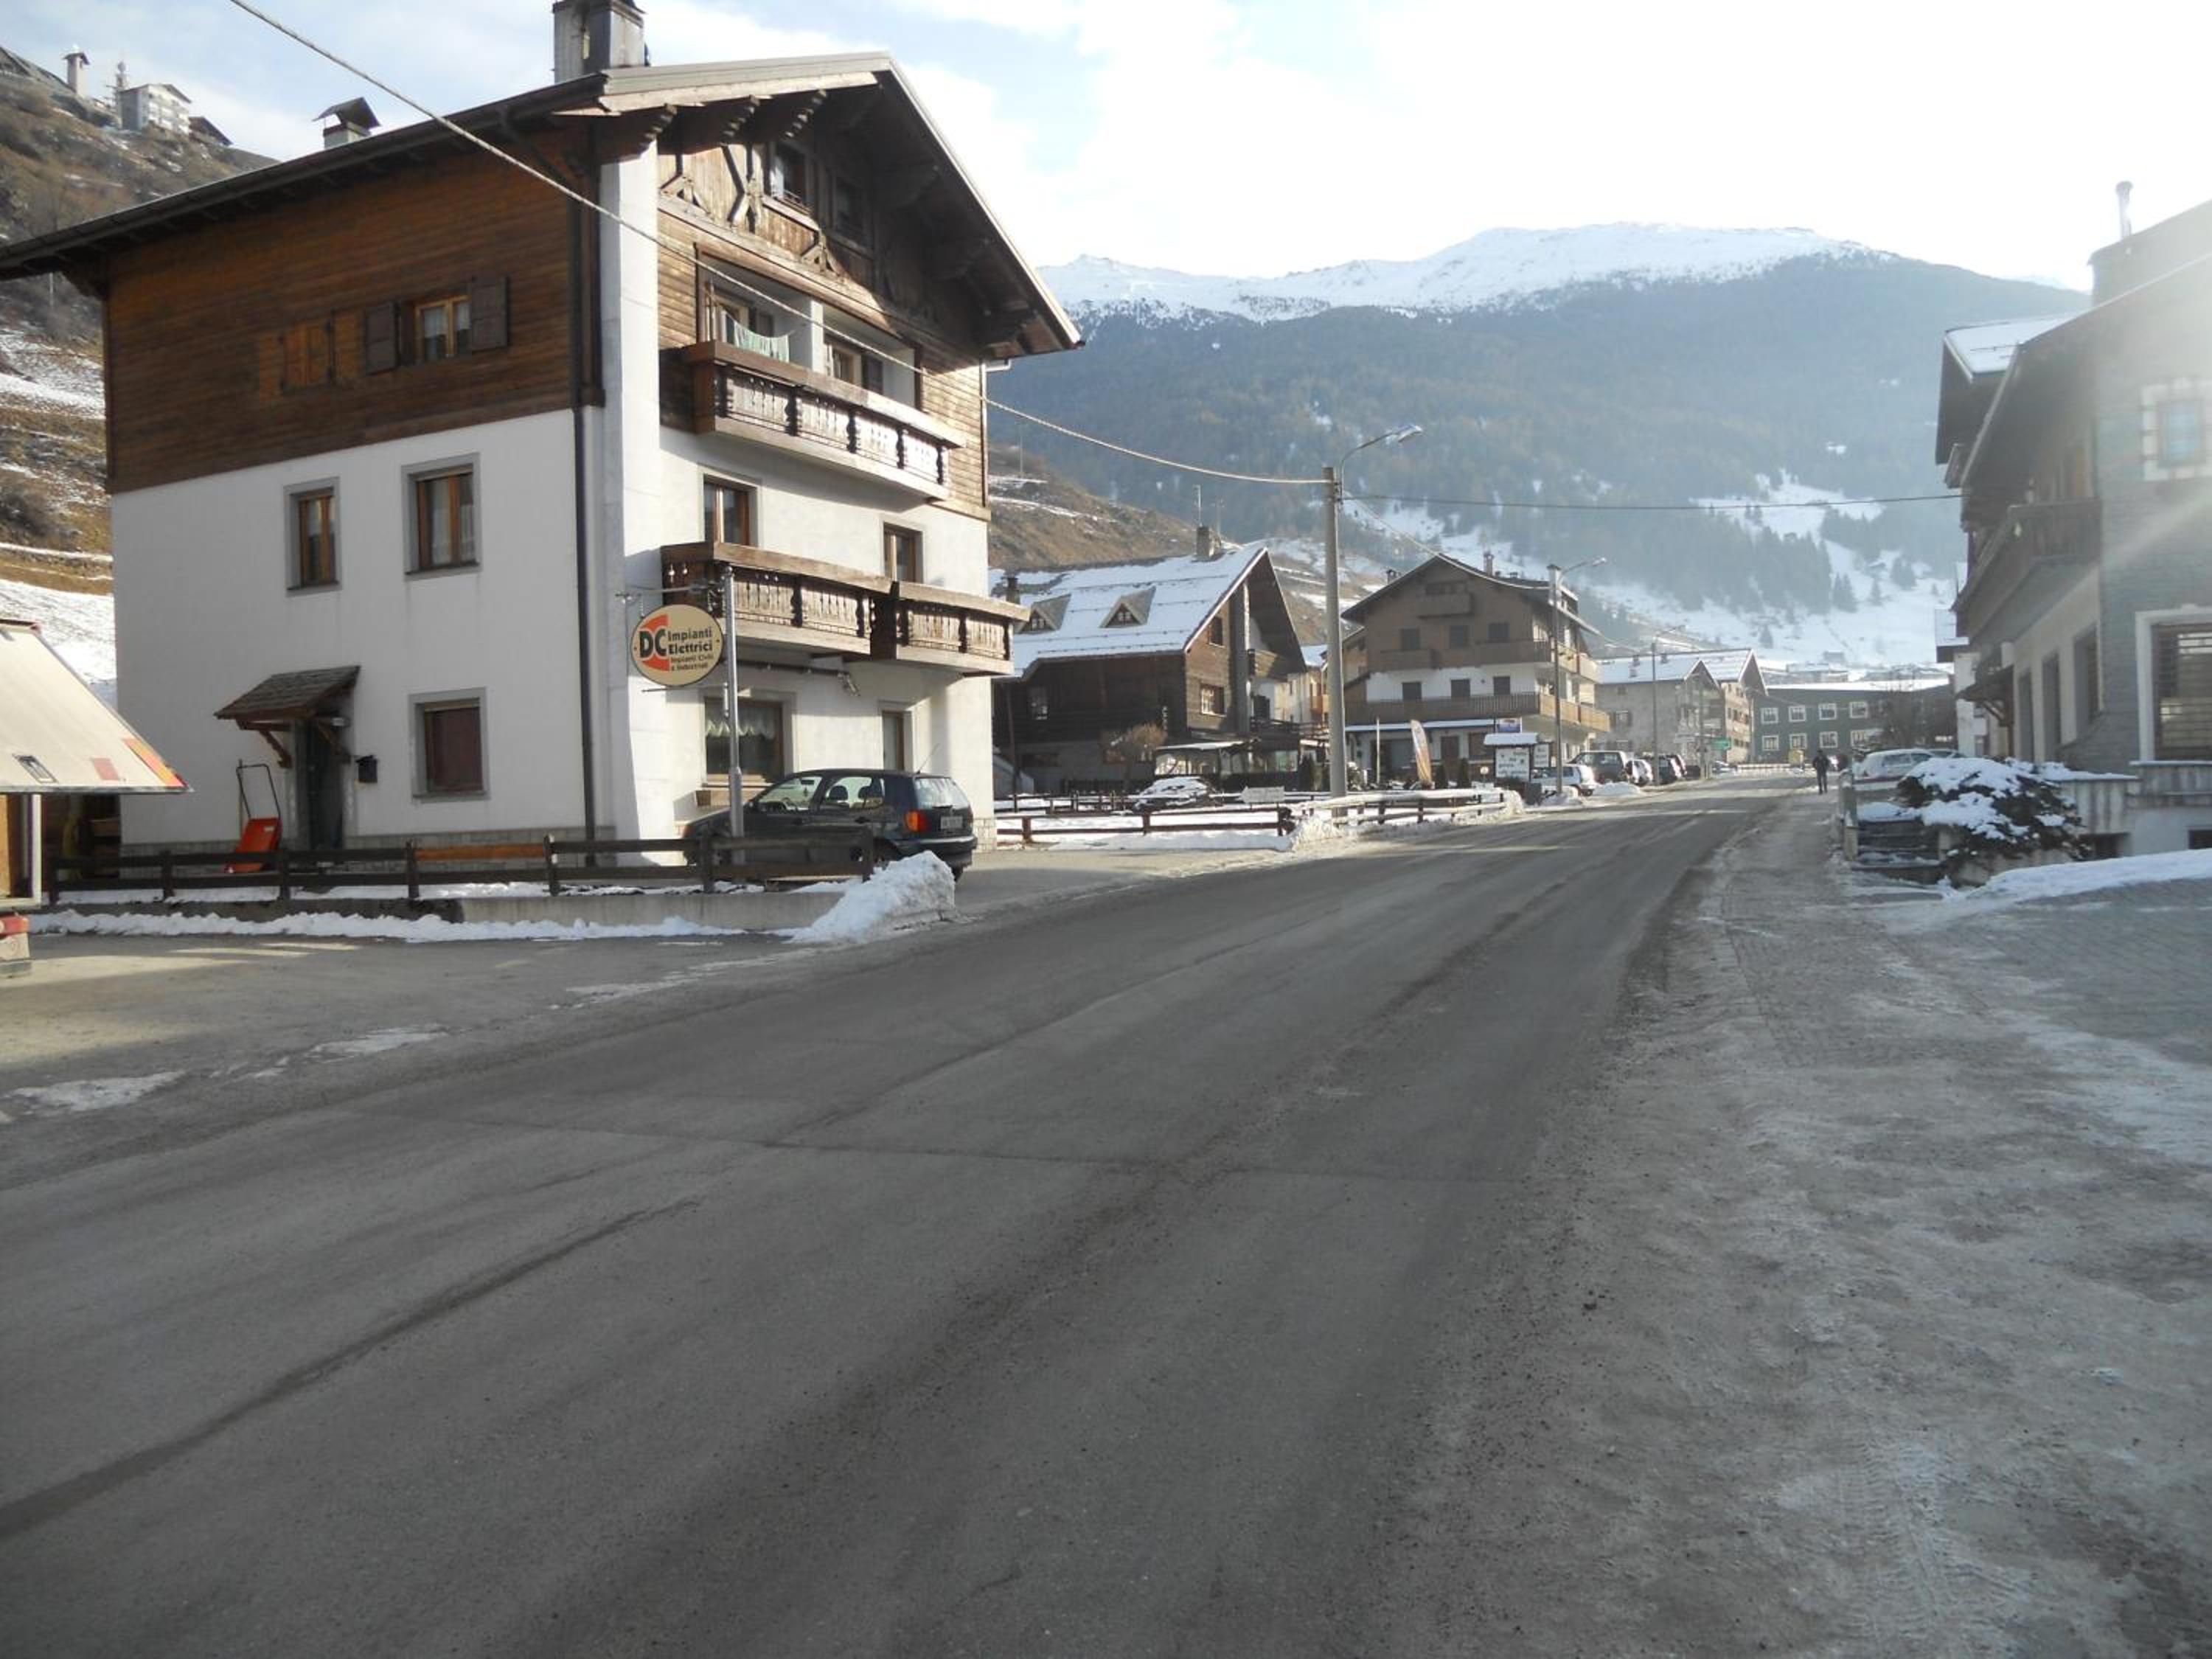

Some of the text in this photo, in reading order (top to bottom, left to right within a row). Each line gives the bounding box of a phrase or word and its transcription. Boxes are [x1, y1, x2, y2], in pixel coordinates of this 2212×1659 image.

[667, 627, 712, 642] Impianti
[640, 629, 667, 658] DC
[668, 640, 712, 655] Elettrici
